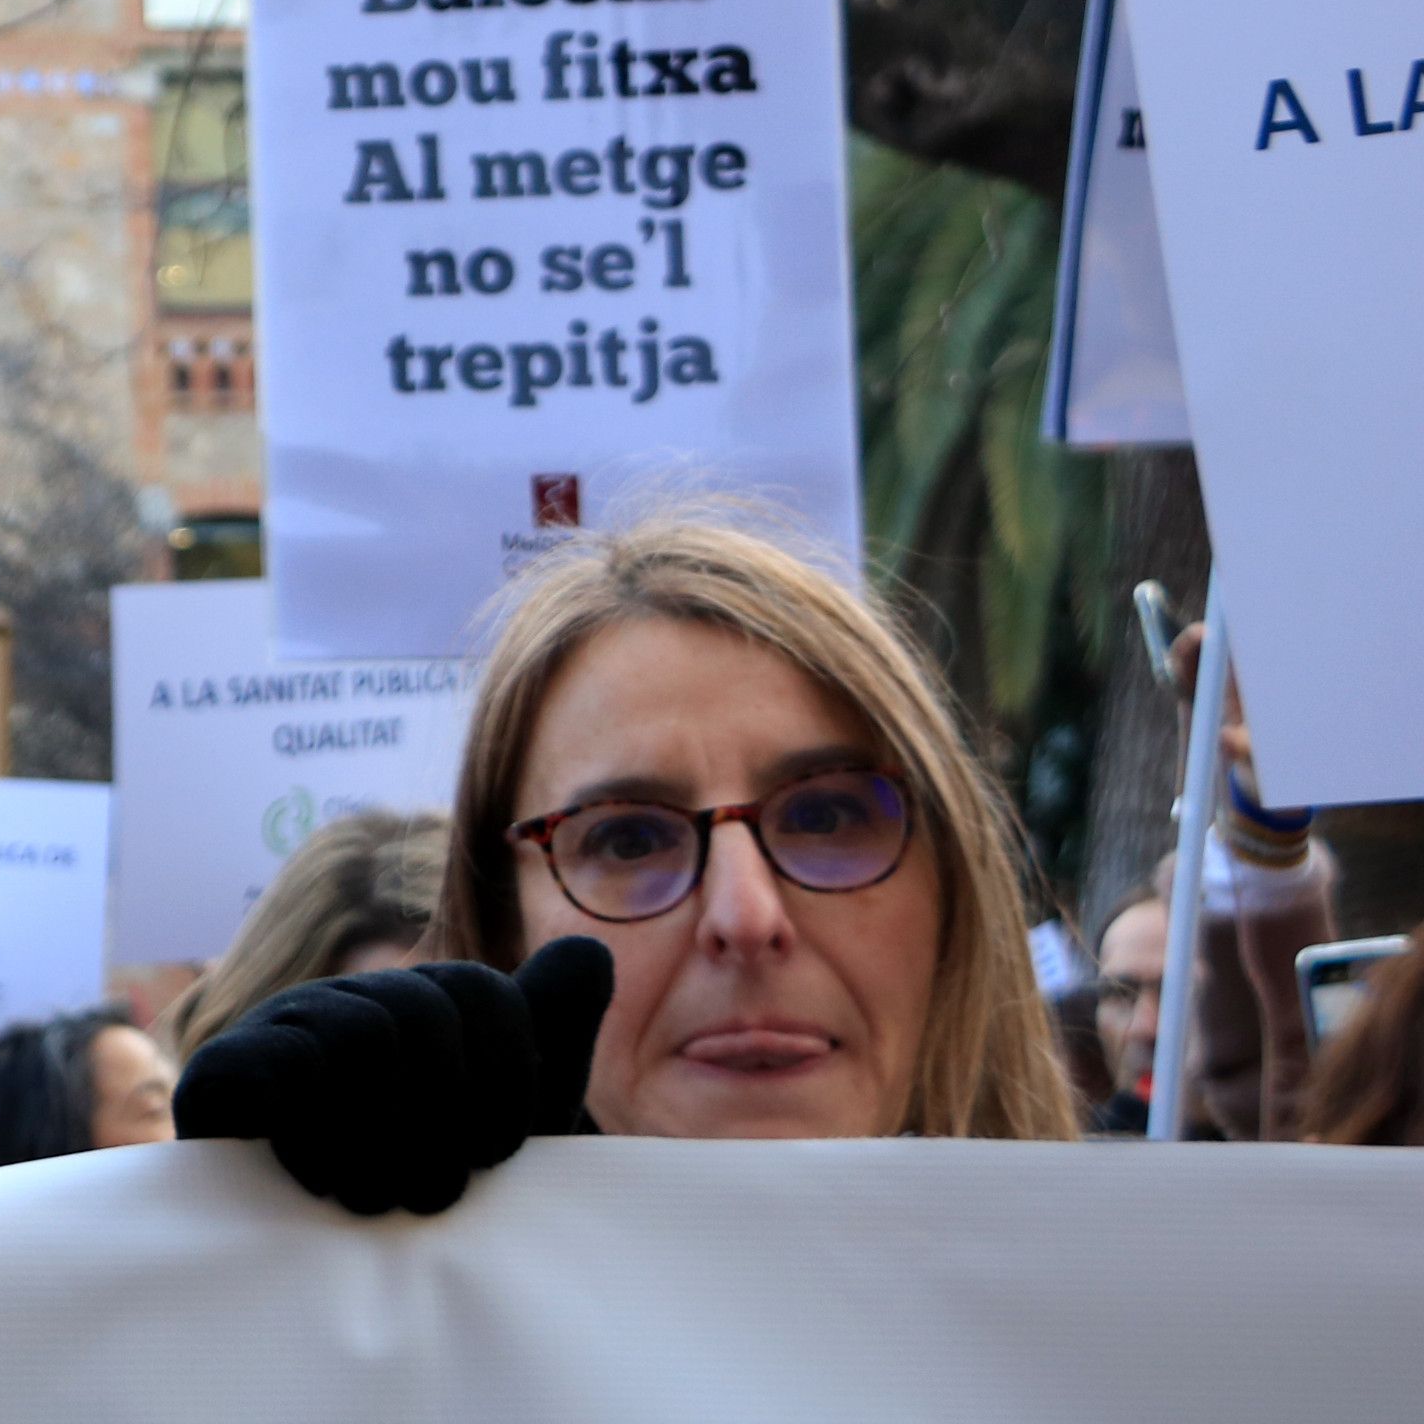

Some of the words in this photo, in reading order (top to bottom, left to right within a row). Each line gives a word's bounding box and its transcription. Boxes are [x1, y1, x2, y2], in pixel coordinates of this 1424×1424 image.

[328, 58, 516, 110] mou
[544, 32, 760, 100] fitxa
[1255, 78, 1321, 150] A
[346, 134, 446, 203] Al
[469, 135, 748, 210] metge
[406, 248, 515, 296] no
[385, 319, 719, 407] trepitja
[152, 681, 173, 707] A
[181, 680, 219, 707] LA
[228, 672, 344, 705] SANITAT
[273, 716, 403, 756] QUALITAT
